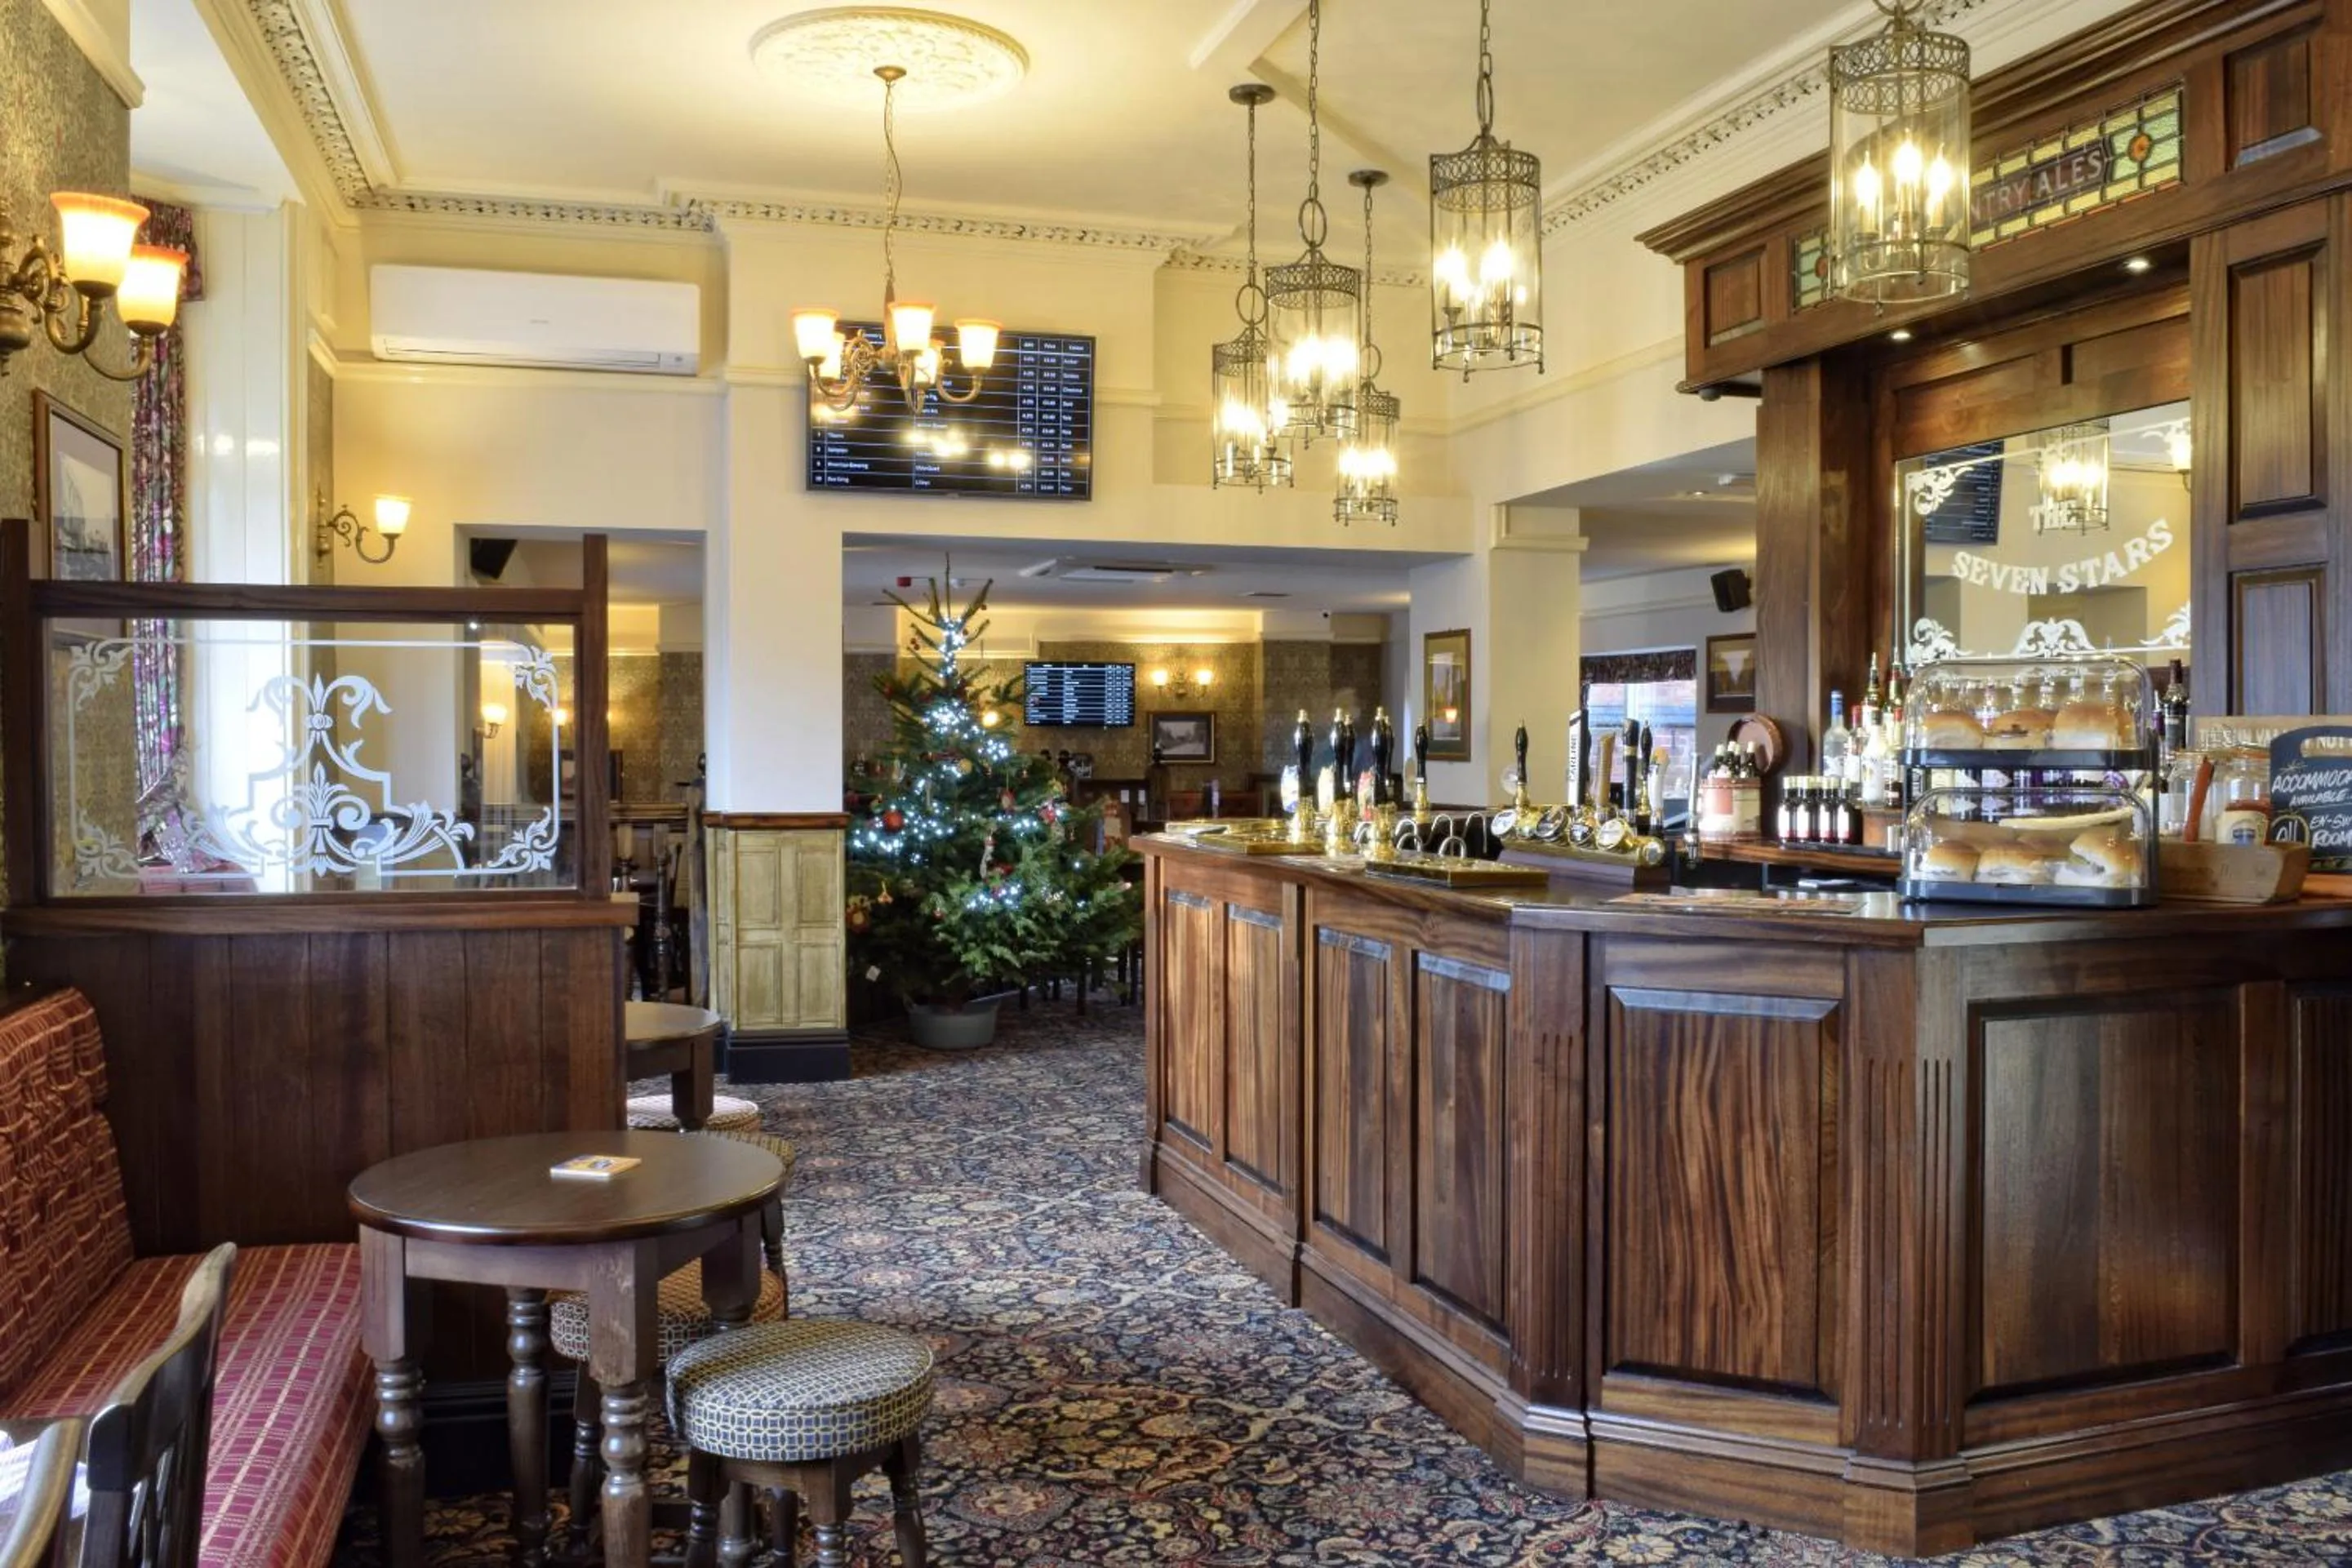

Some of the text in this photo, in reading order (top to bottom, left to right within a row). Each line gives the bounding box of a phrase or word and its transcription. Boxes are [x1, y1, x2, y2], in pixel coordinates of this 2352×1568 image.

[2039, 149, 2104, 194] ALES
[2029, 500, 2079, 531] THE
[1952, 517, 2174, 595] SEVEN STARS
